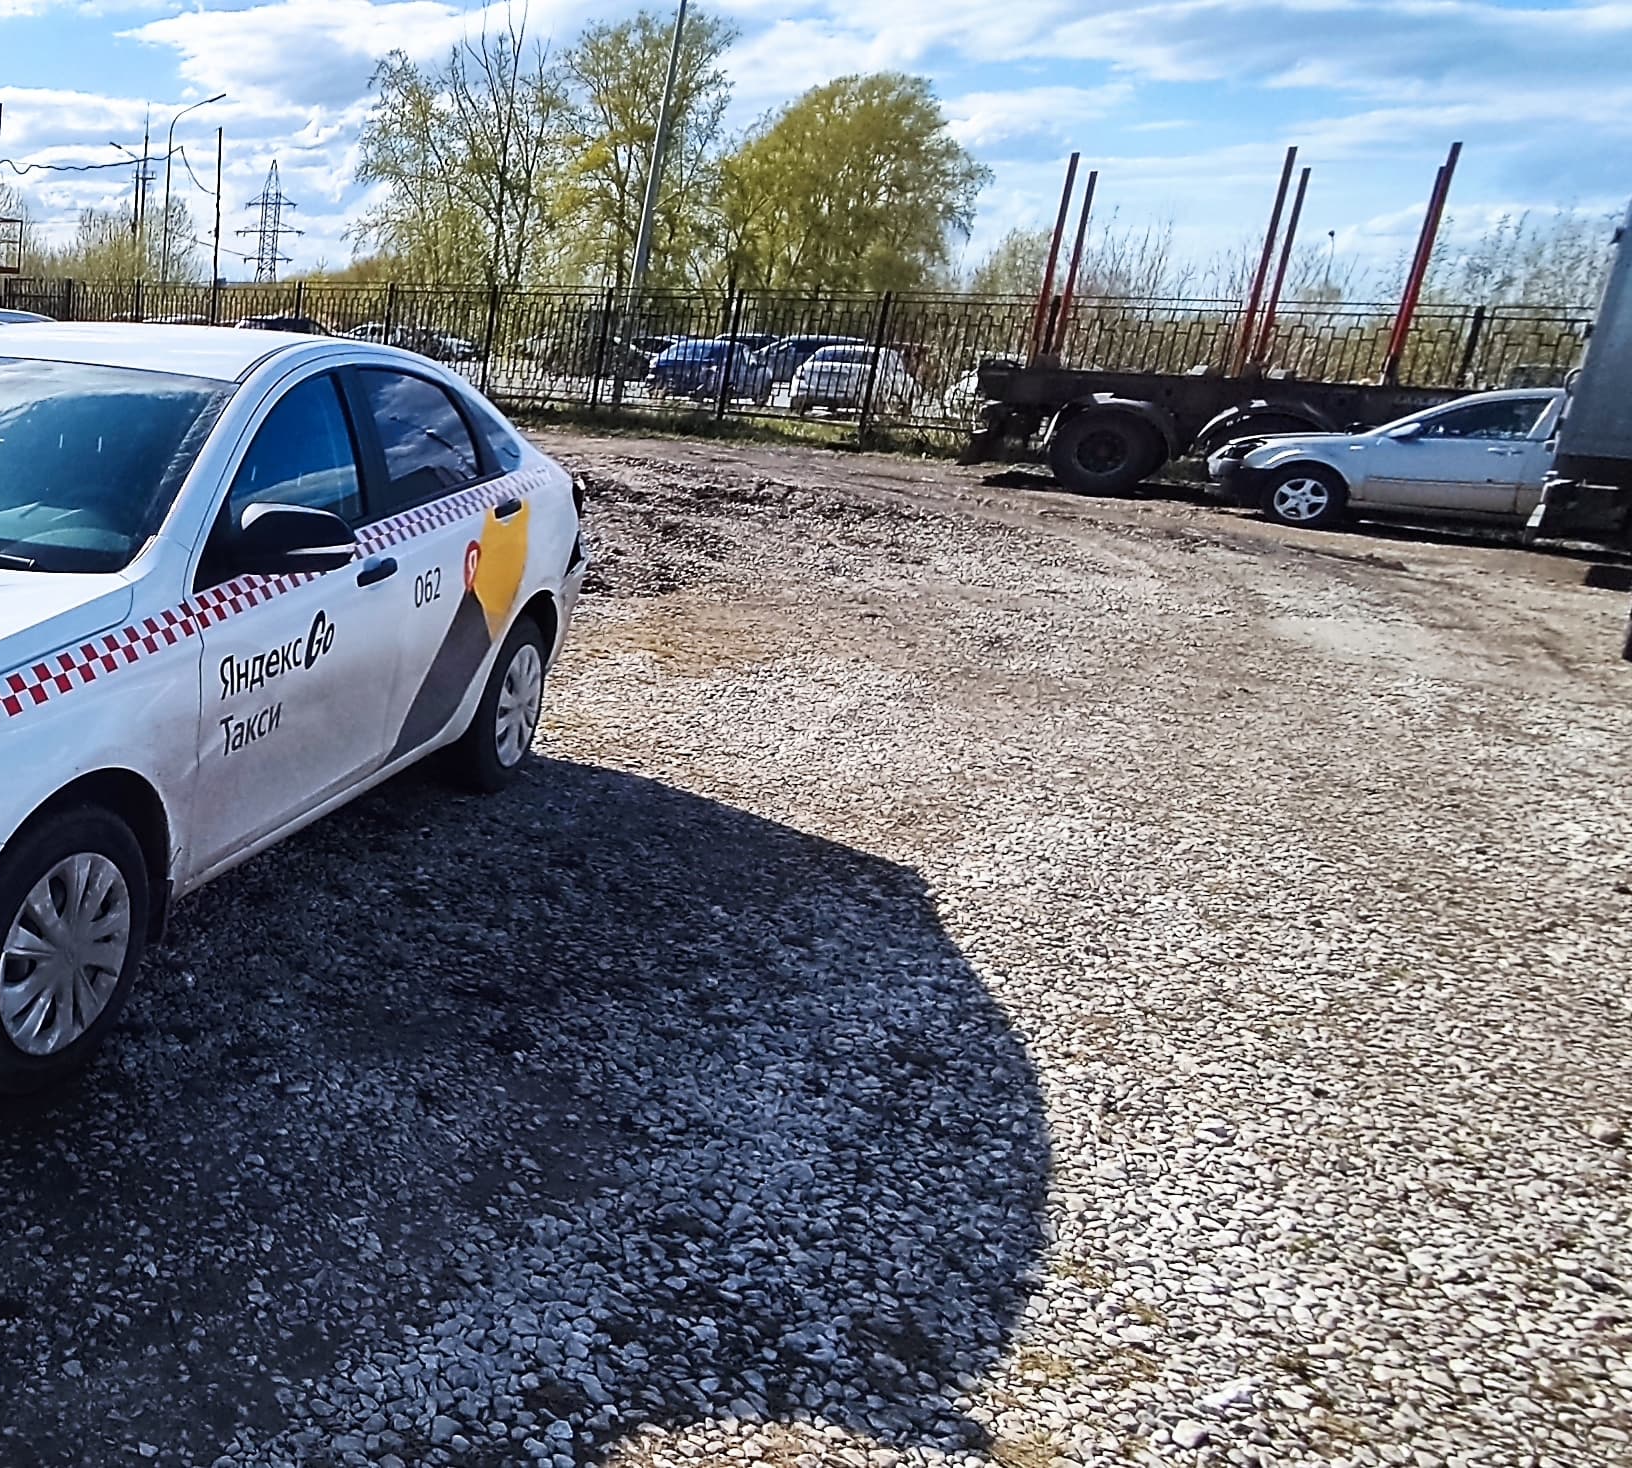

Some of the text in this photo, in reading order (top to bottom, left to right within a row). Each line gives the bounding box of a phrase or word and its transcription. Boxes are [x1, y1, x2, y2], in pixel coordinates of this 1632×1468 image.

[414, 567, 441, 608] 062
[219, 609, 335, 700] Яндекс Go
[219, 702, 283, 756] Такси
